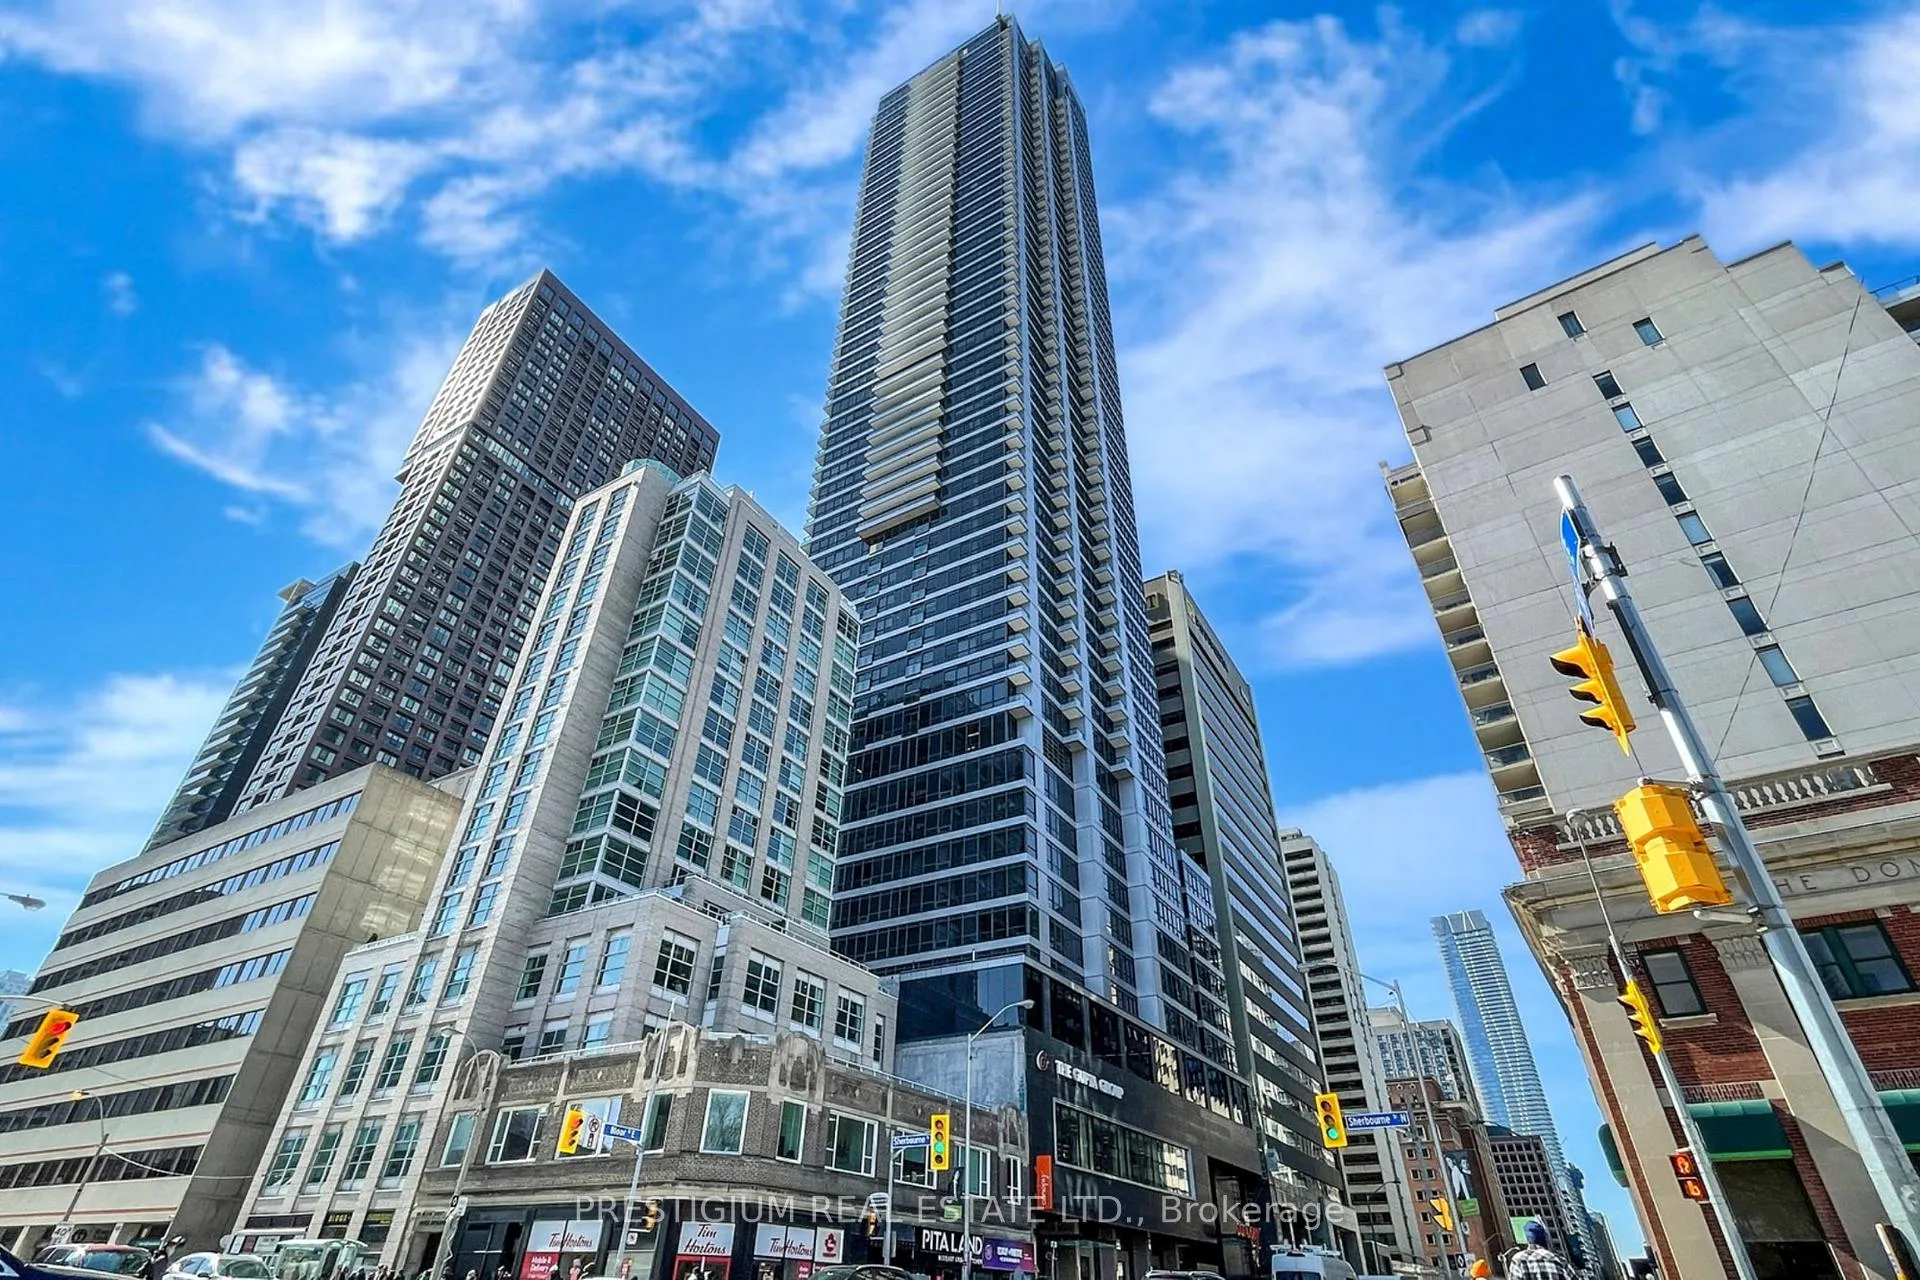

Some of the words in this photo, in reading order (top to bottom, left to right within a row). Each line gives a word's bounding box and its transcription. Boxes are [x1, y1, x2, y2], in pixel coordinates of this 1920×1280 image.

[1773, 874, 1817, 895] HE
[1348, 1116, 1390, 1127] Sherbourne
[1400, 1113, 1407, 1124] N
[610, 1125, 626, 1137] Bloor
[894, 1136, 926, 1146] Sherbourne
[697, 1223, 717, 1239] Tim
[562, 1232, 593, 1248] Hortons
[684, 1238, 726, 1255] Hortons
[785, 1238, 813, 1257] Hortons
